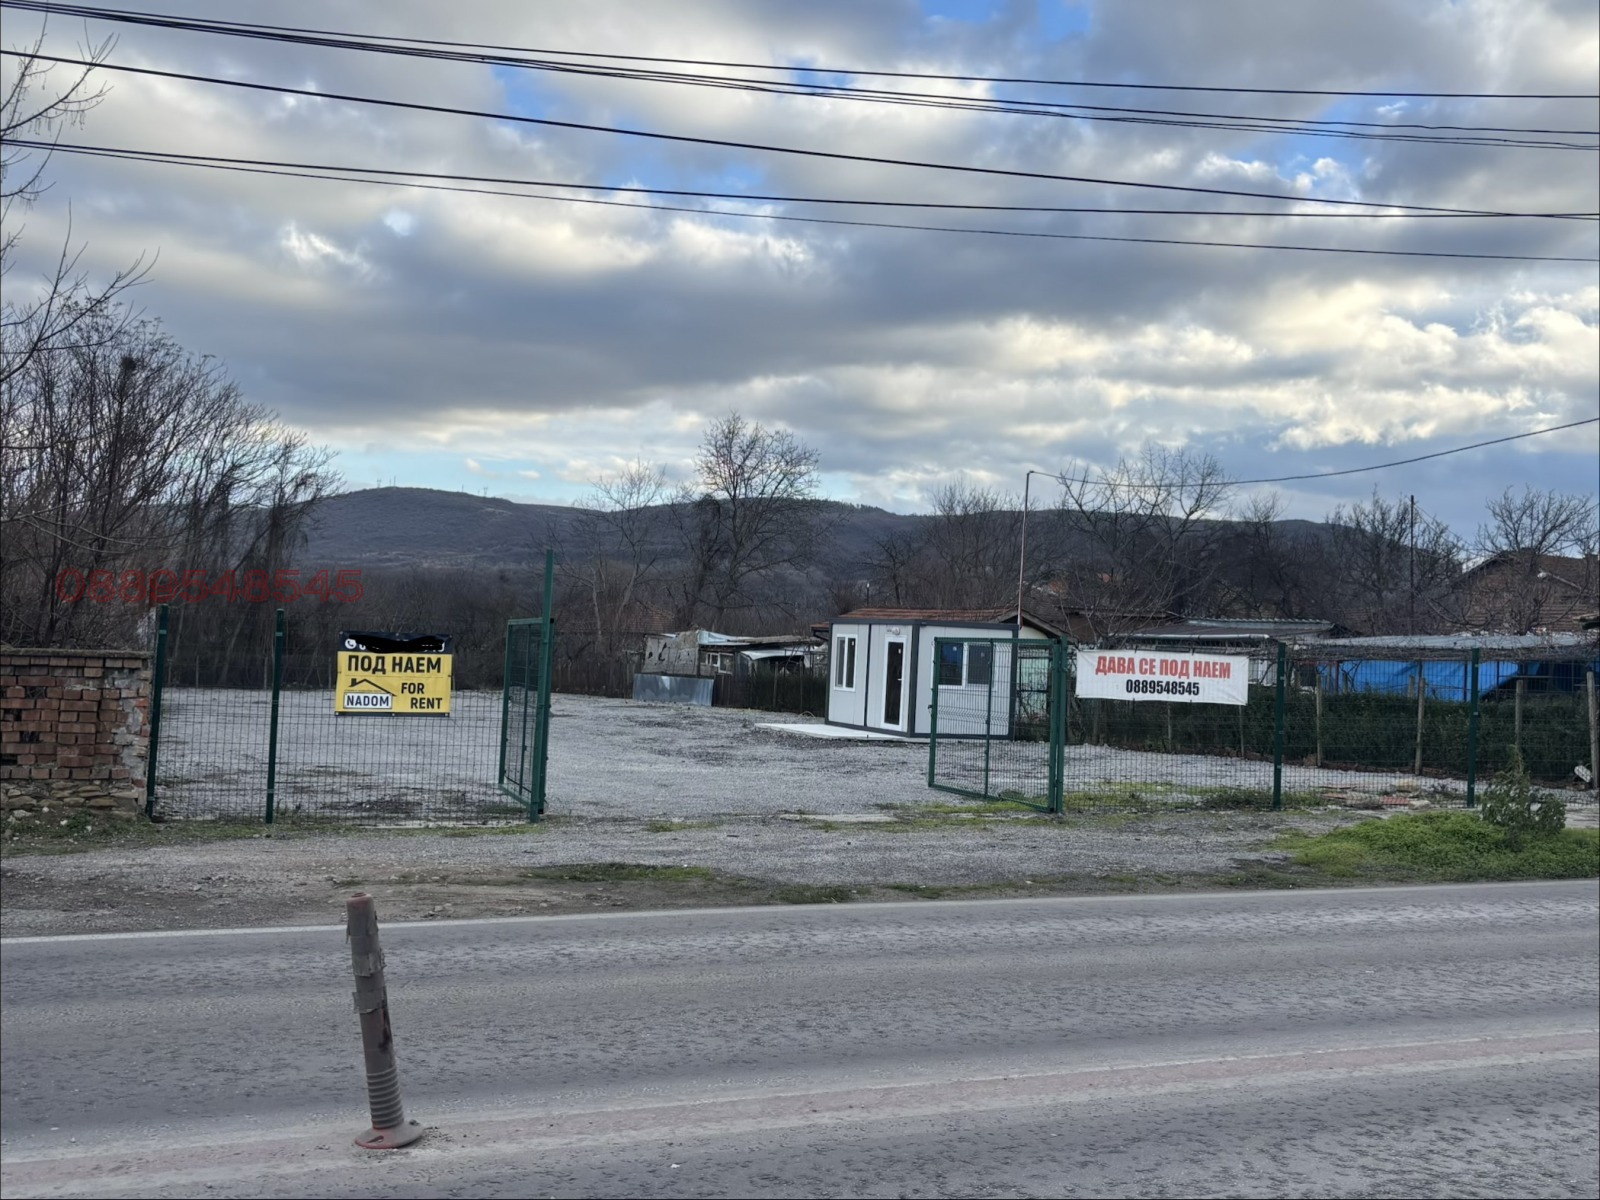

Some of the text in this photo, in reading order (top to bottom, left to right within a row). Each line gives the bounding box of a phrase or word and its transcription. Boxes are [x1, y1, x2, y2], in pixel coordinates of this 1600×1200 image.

[348, 655, 441, 674] ПОД НАЕМ
[1095, 655, 1231, 679] ДАВА СЕ ПОД НАЕМ
[401, 682, 425, 694] FOR
[1126, 679, 1200, 695] 0889548545
[346, 695, 389, 707] NADOM
[410, 697, 442, 709] RENT
